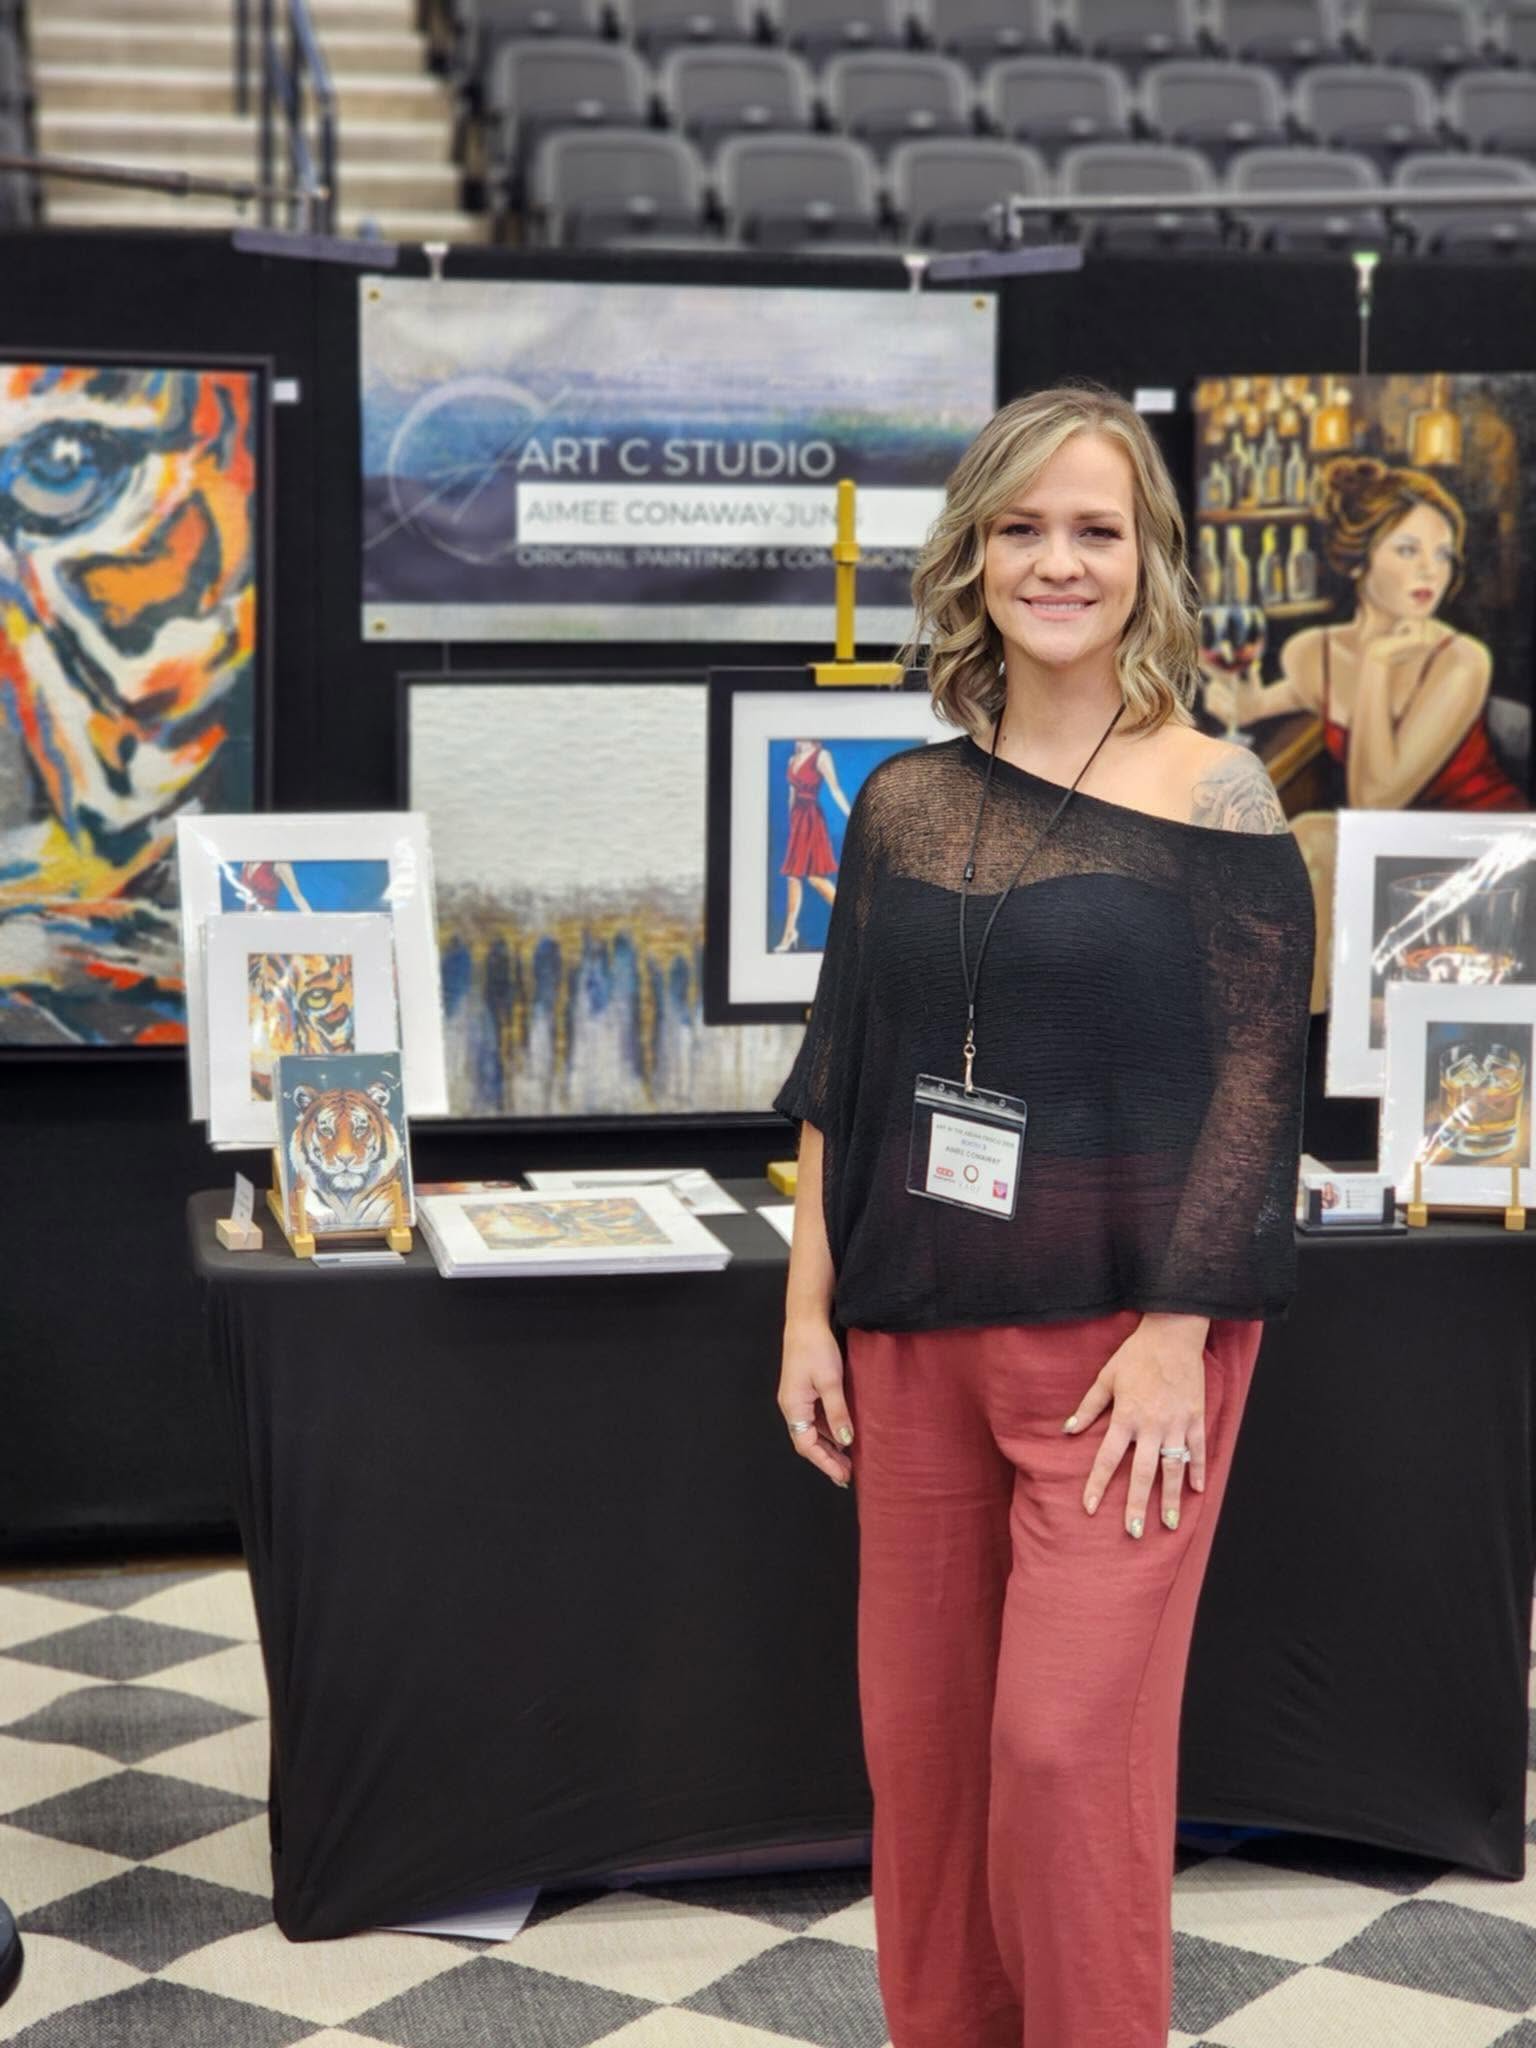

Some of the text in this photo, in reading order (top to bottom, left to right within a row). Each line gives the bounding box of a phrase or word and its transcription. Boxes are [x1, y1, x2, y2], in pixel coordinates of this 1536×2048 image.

[516, 437, 836, 479] ART C STUDIO
[526, 499, 864, 529] AIMEE CONAWAY-JUN
[517, 548, 628, 569] ORIGINAL
[634, 547, 758, 570] PAINTINGS
